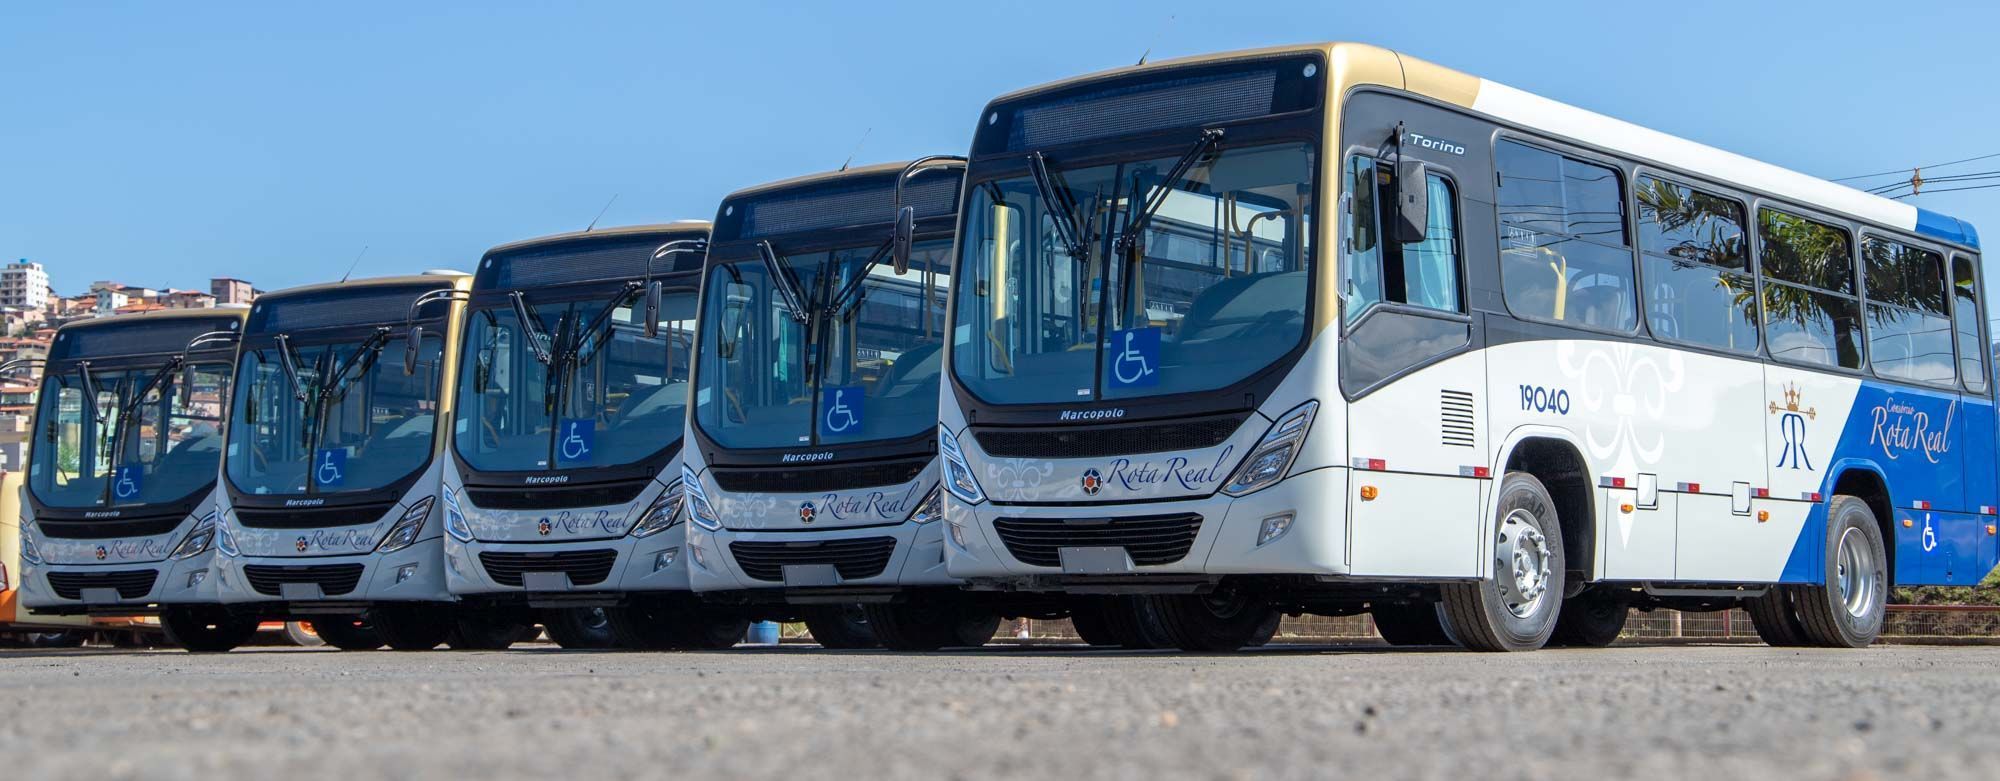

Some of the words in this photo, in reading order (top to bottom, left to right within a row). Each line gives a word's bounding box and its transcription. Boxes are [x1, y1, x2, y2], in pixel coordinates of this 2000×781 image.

[1410, 133, 1465, 155] Torino
[1519, 384, 1570, 415] 19040
[1060, 408, 1125, 420] Marcopolo
[1870, 406, 1912, 460] Rota
[1912, 400, 1956, 464] Real
[782, 451, 834, 463] Marcopolo
[1107, 458, 1162, 491] Rota
[1163, 444, 1234, 491] Real
[525, 475, 569, 484] Marcopolo
[286, 498, 325, 507] Marcopolo
[819, 493, 863, 520] Rota
[864, 481, 920, 519] Real
[555, 510, 592, 534] Rota
[592, 501, 640, 534] Real
[109, 539, 138, 559] Rota
[137, 532, 178, 559] Real
[309, 529, 342, 550] Rota
[342, 522, 385, 550] Real
